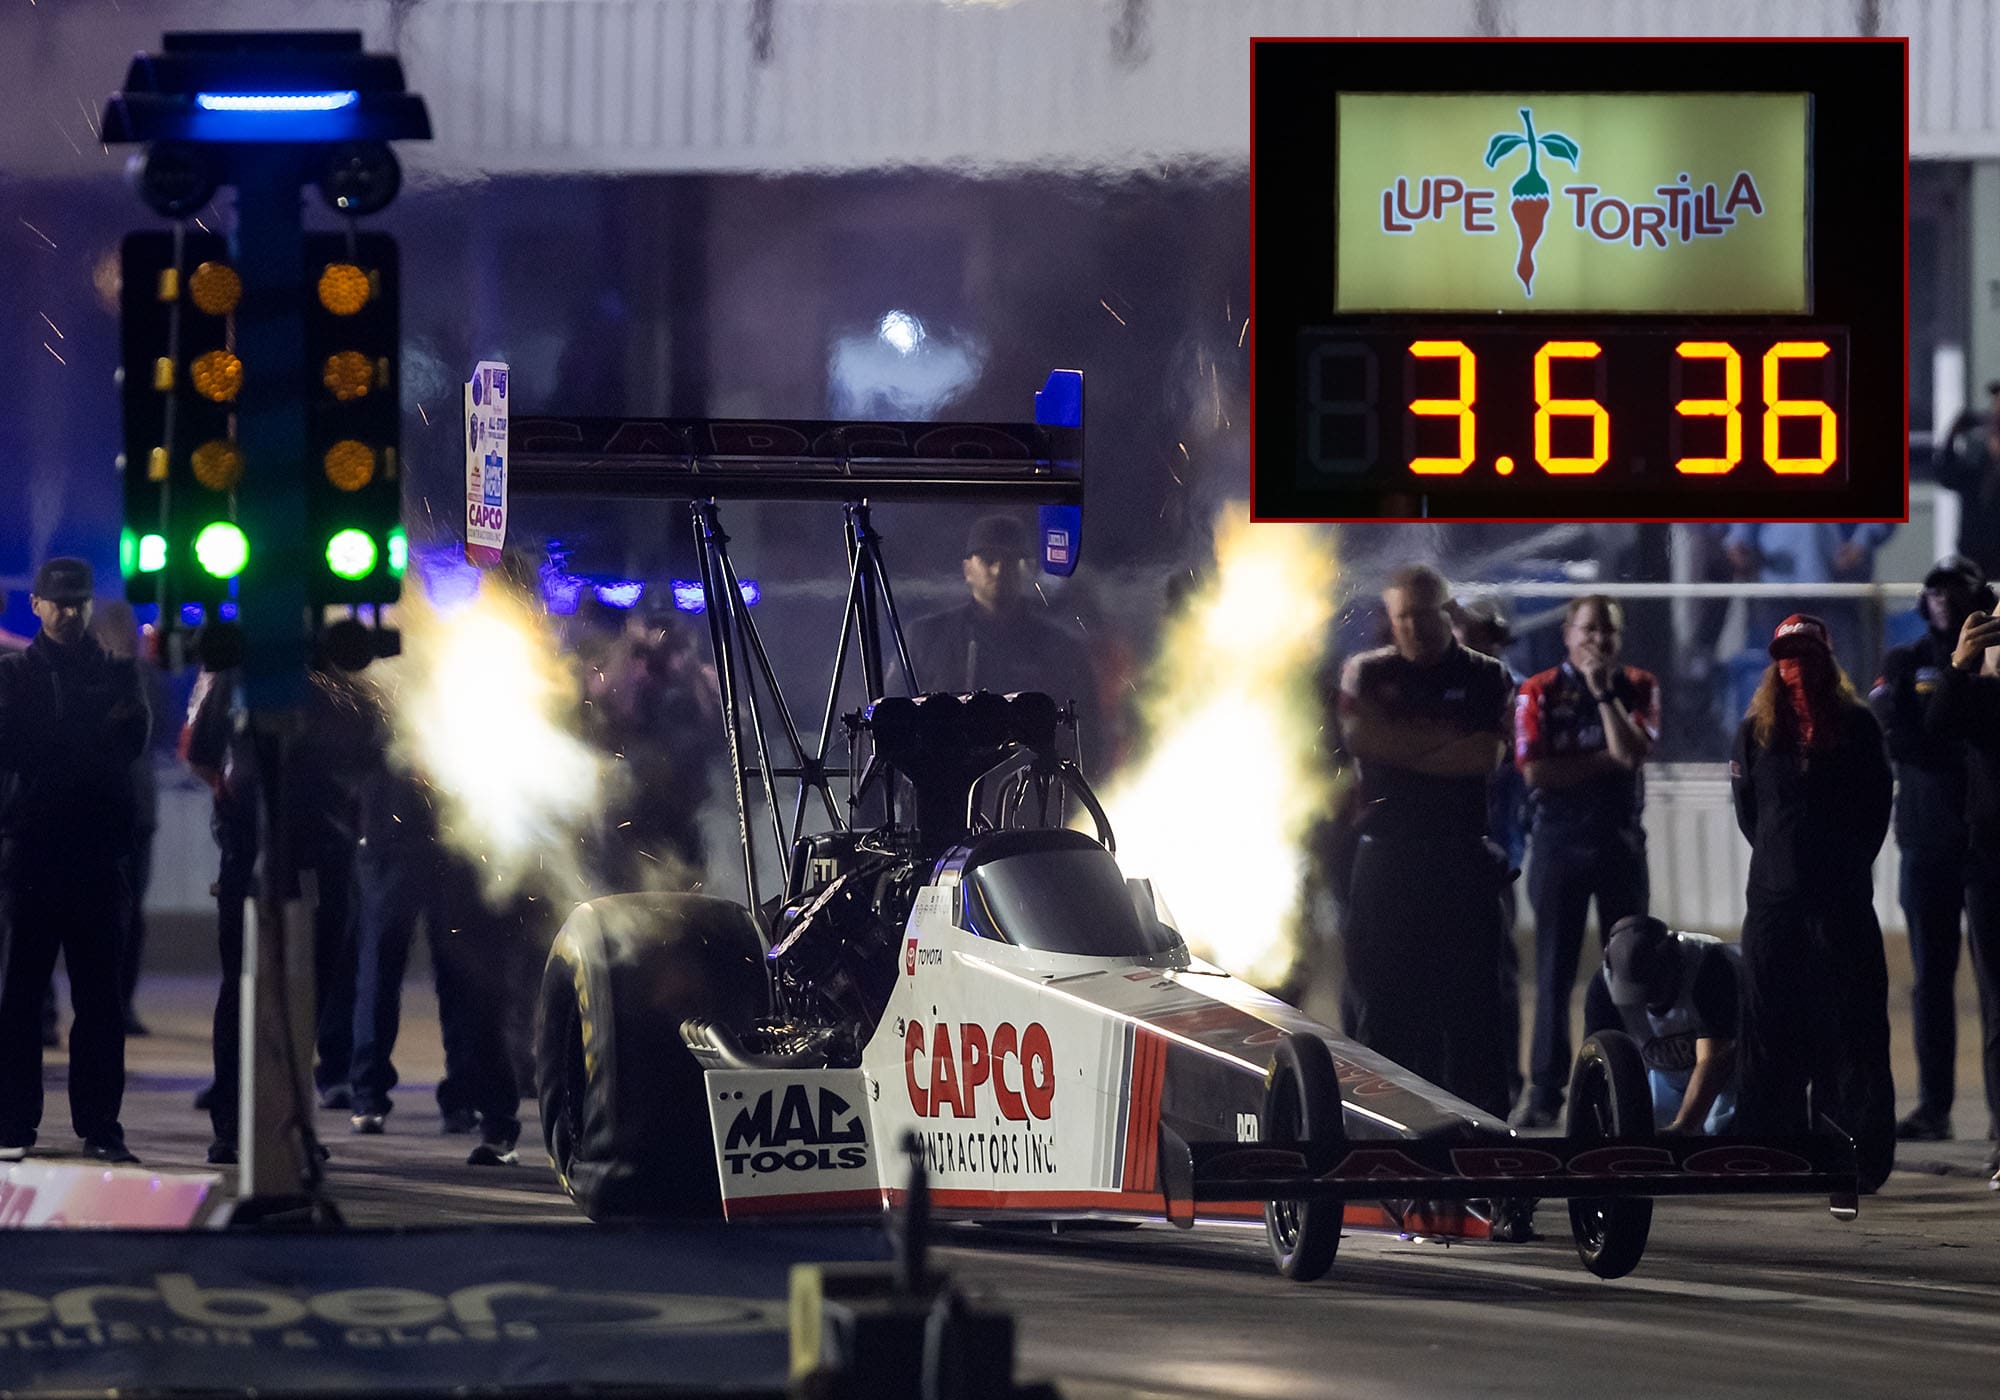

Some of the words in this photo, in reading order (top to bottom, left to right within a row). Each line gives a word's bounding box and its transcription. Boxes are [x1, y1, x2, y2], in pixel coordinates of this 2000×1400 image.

[1383, 178, 1497, 233] LUPE
[1564, 172, 1763, 248] TORTILLA
[469, 503, 503, 530] CAPCO
[918, 948, 942, 965] TOYOTA
[904, 1019, 1056, 1121] CAPCO
[725, 1084, 866, 1150] MAC
[724, 1147, 867, 1174] TOOLS
[904, 1131, 1019, 1174] ONTRACTORS
[1024, 1133, 1057, 1174] INC.
[1202, 1146, 1812, 1178] CAPCO
